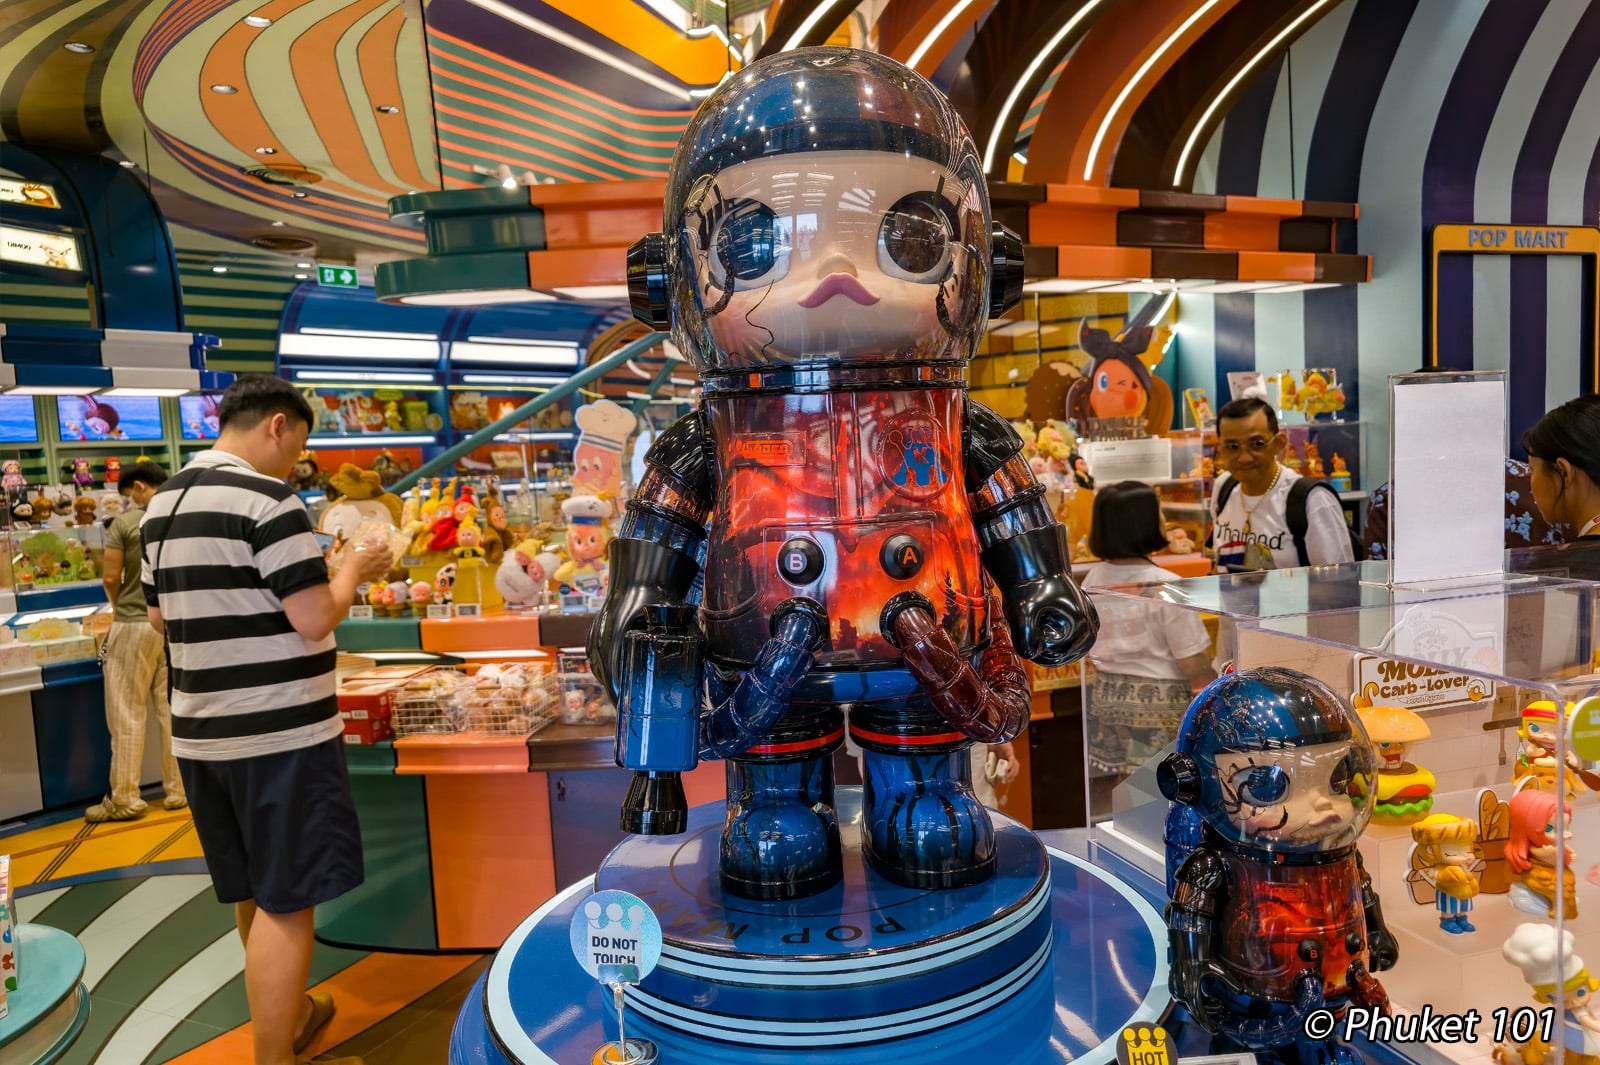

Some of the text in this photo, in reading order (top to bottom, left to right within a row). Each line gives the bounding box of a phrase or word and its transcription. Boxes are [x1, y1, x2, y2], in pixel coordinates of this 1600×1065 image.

[1468, 228, 1568, 248] POP MART
[913, 447, 929, 464] K
[1216, 521, 1286, 550] Thailand
[789, 554, 804, 571] B
[902, 548, 918, 565] A
[781, 917, 906, 944] POP
[591, 935, 638, 951] DO NOT
[593, 953, 636, 965] TOUCH
[1132, 1051, 1164, 1065] HOT
